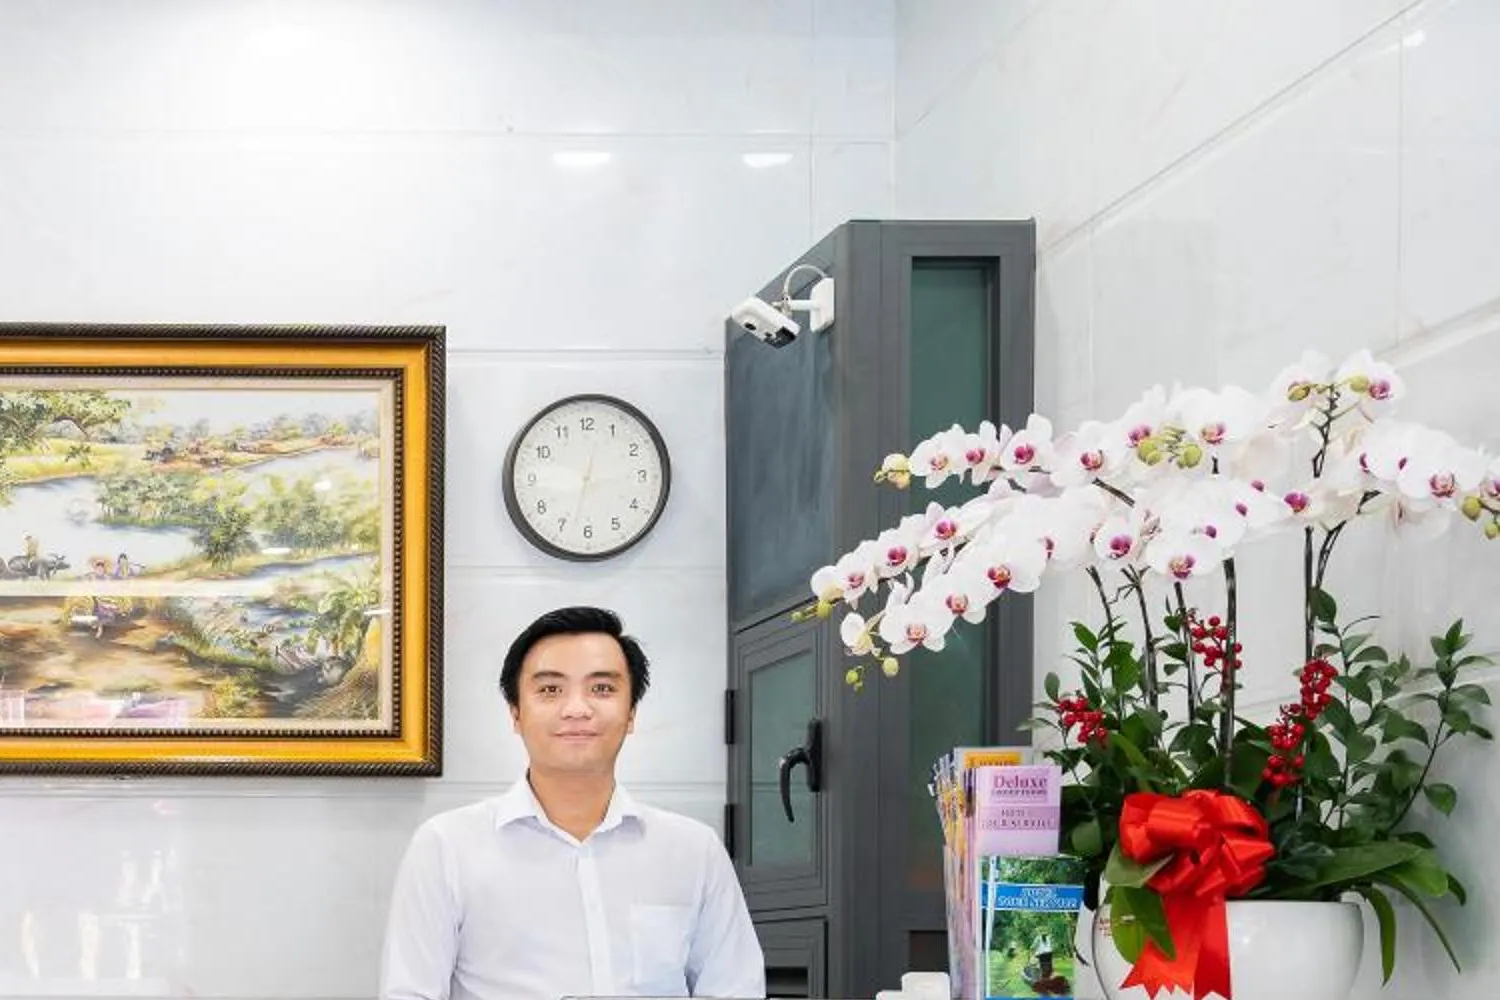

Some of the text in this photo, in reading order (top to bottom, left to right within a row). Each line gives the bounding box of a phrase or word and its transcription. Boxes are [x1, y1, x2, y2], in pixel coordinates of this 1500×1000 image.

[580, 418, 594, 431] 12
[610, 423, 615, 437] 1
[556, 427, 569, 438] 11
[537, 446, 550, 458] 10
[629, 443, 638, 456] 2
[528, 474, 536, 486] 9
[638, 470, 647, 482] 3
[537, 500, 546, 514] 8
[629, 499, 638, 509] 4
[558, 519, 566, 531] 7
[612, 518, 620, 530] 5
[583, 526, 592, 538] 6
[994, 774, 1048, 789] Deluxe
